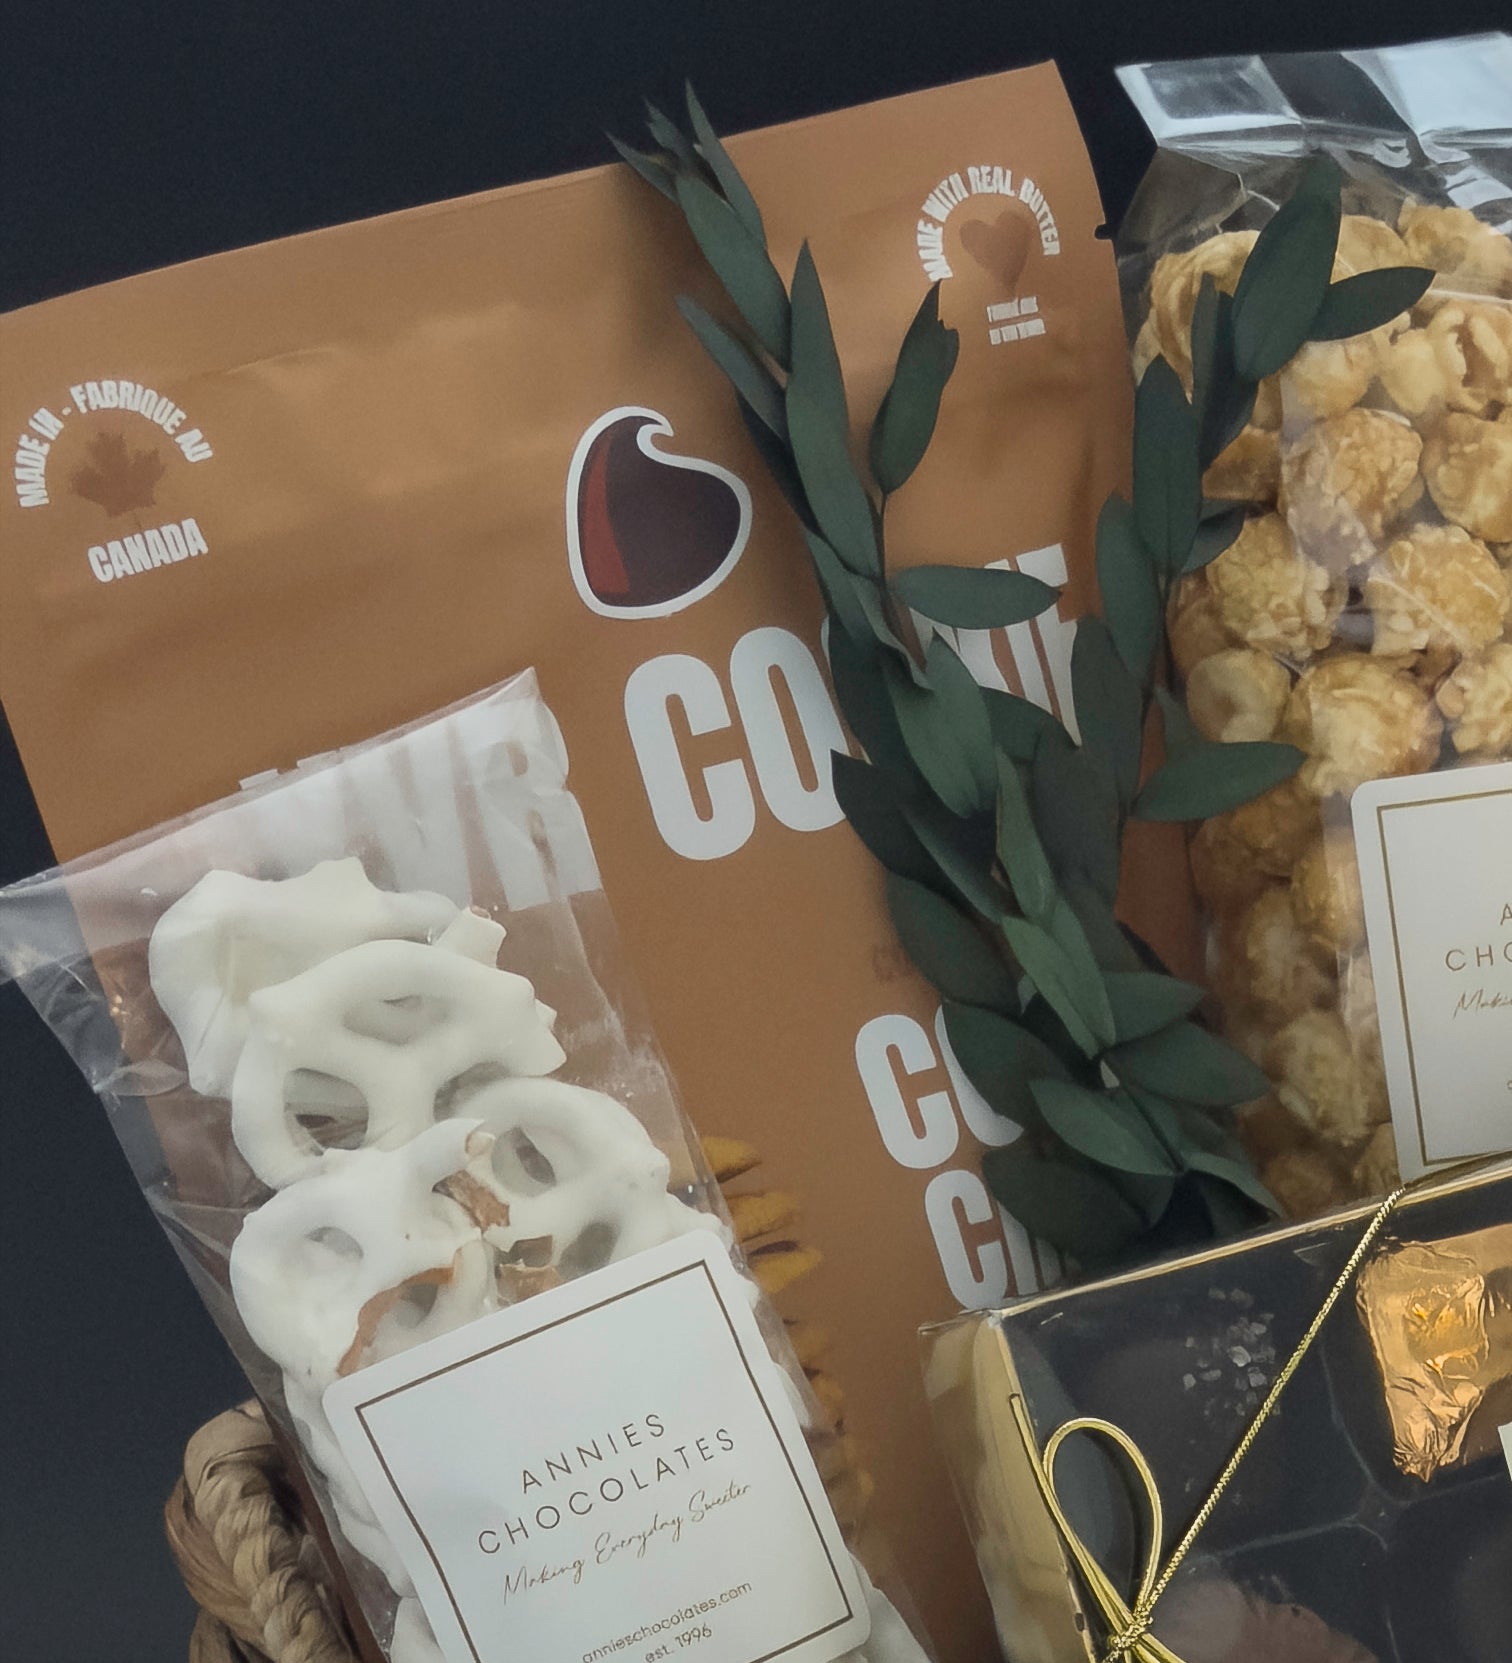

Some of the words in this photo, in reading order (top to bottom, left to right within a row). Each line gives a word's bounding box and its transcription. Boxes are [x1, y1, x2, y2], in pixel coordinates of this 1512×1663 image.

[967, 165, 1015, 197] REAL
[28, 407, 64, 440] IN
[70, 380, 187, 435] FABRIQUE
[15, 434, 50, 507] MADE
[174, 428, 213, 463] AU
[88, 517, 209, 583] CANADA
[521, 1414, 664, 1494] ANNIES
[478, 1428, 734, 1554] CHOCOLATES
[503, 1559, 585, 1605] Making
[675, 1622, 712, 1650] 1996
